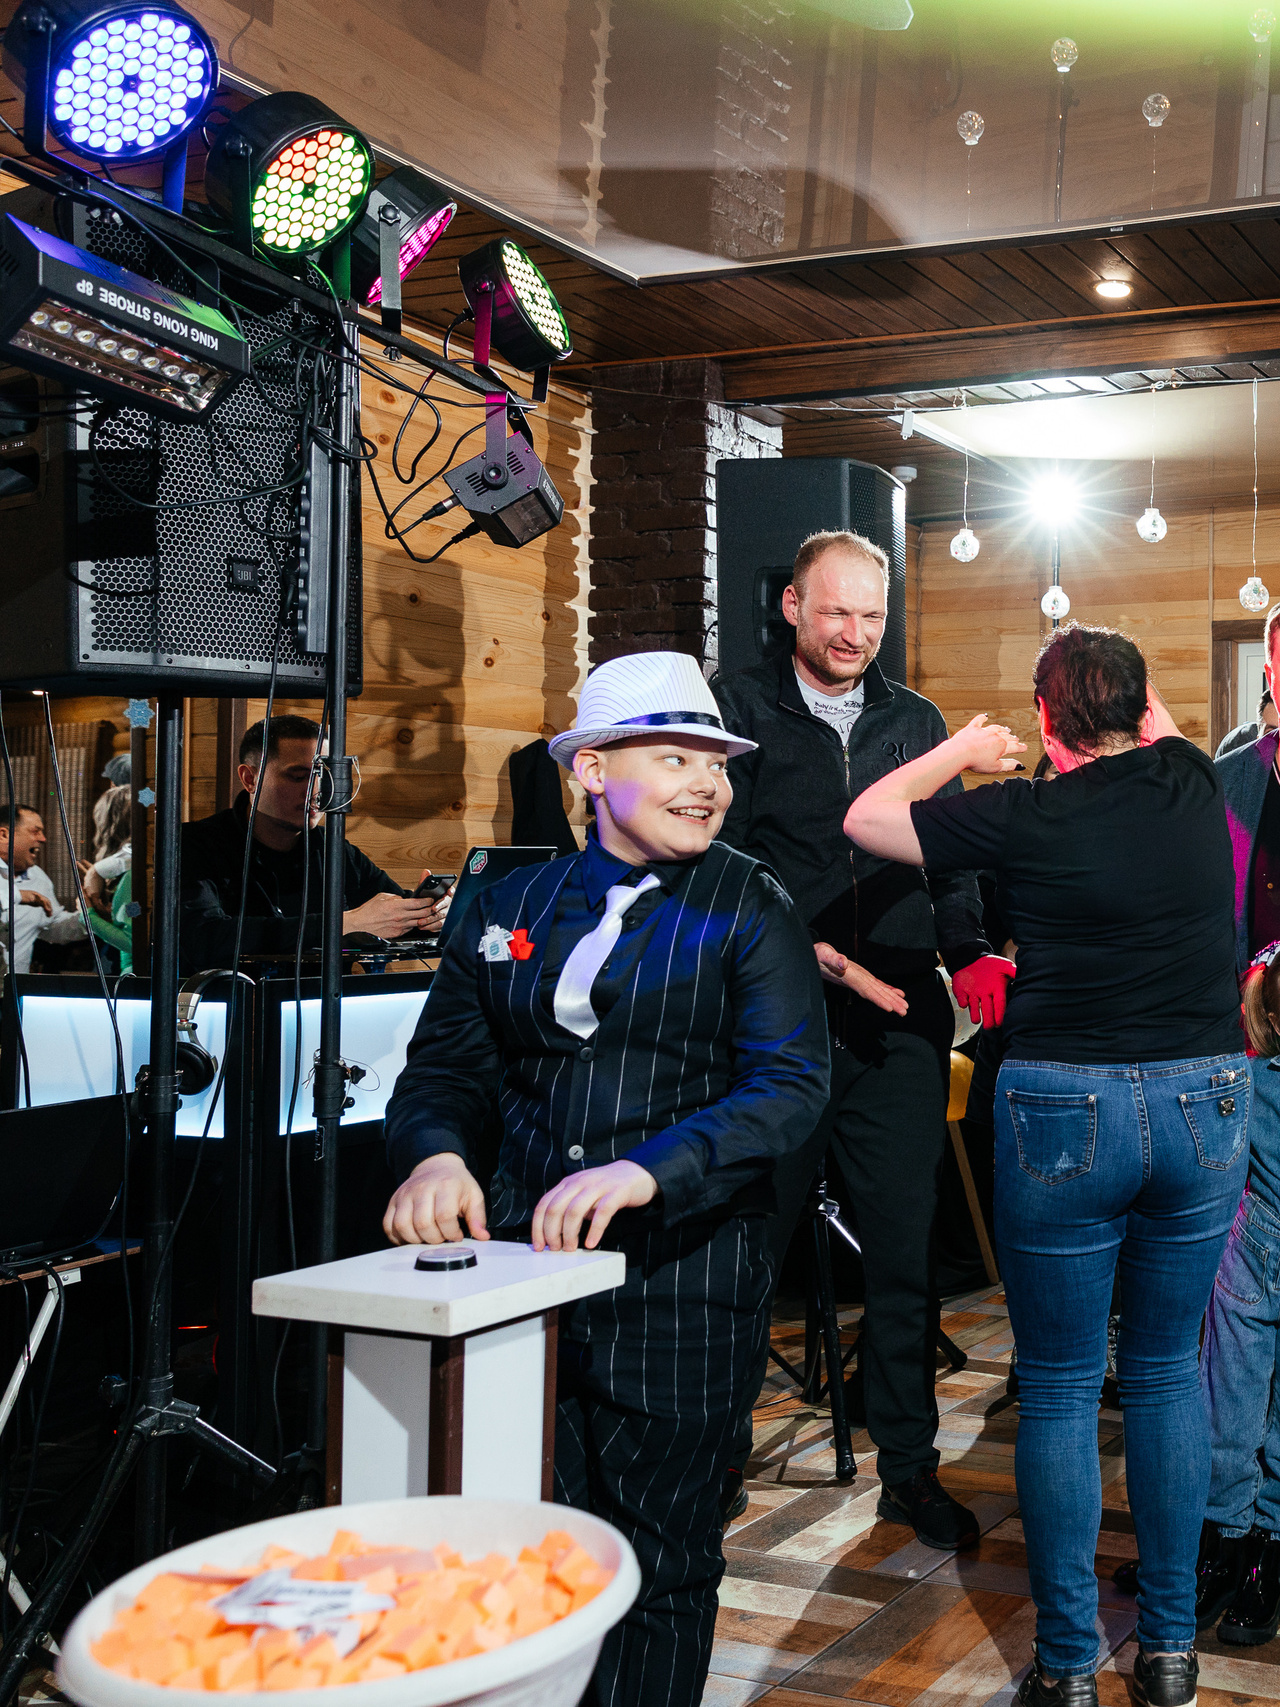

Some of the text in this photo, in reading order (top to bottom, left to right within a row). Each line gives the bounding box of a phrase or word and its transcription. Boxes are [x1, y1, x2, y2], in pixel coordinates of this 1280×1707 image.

[76, 279, 219, 351] KING KONG STROBE 8P
